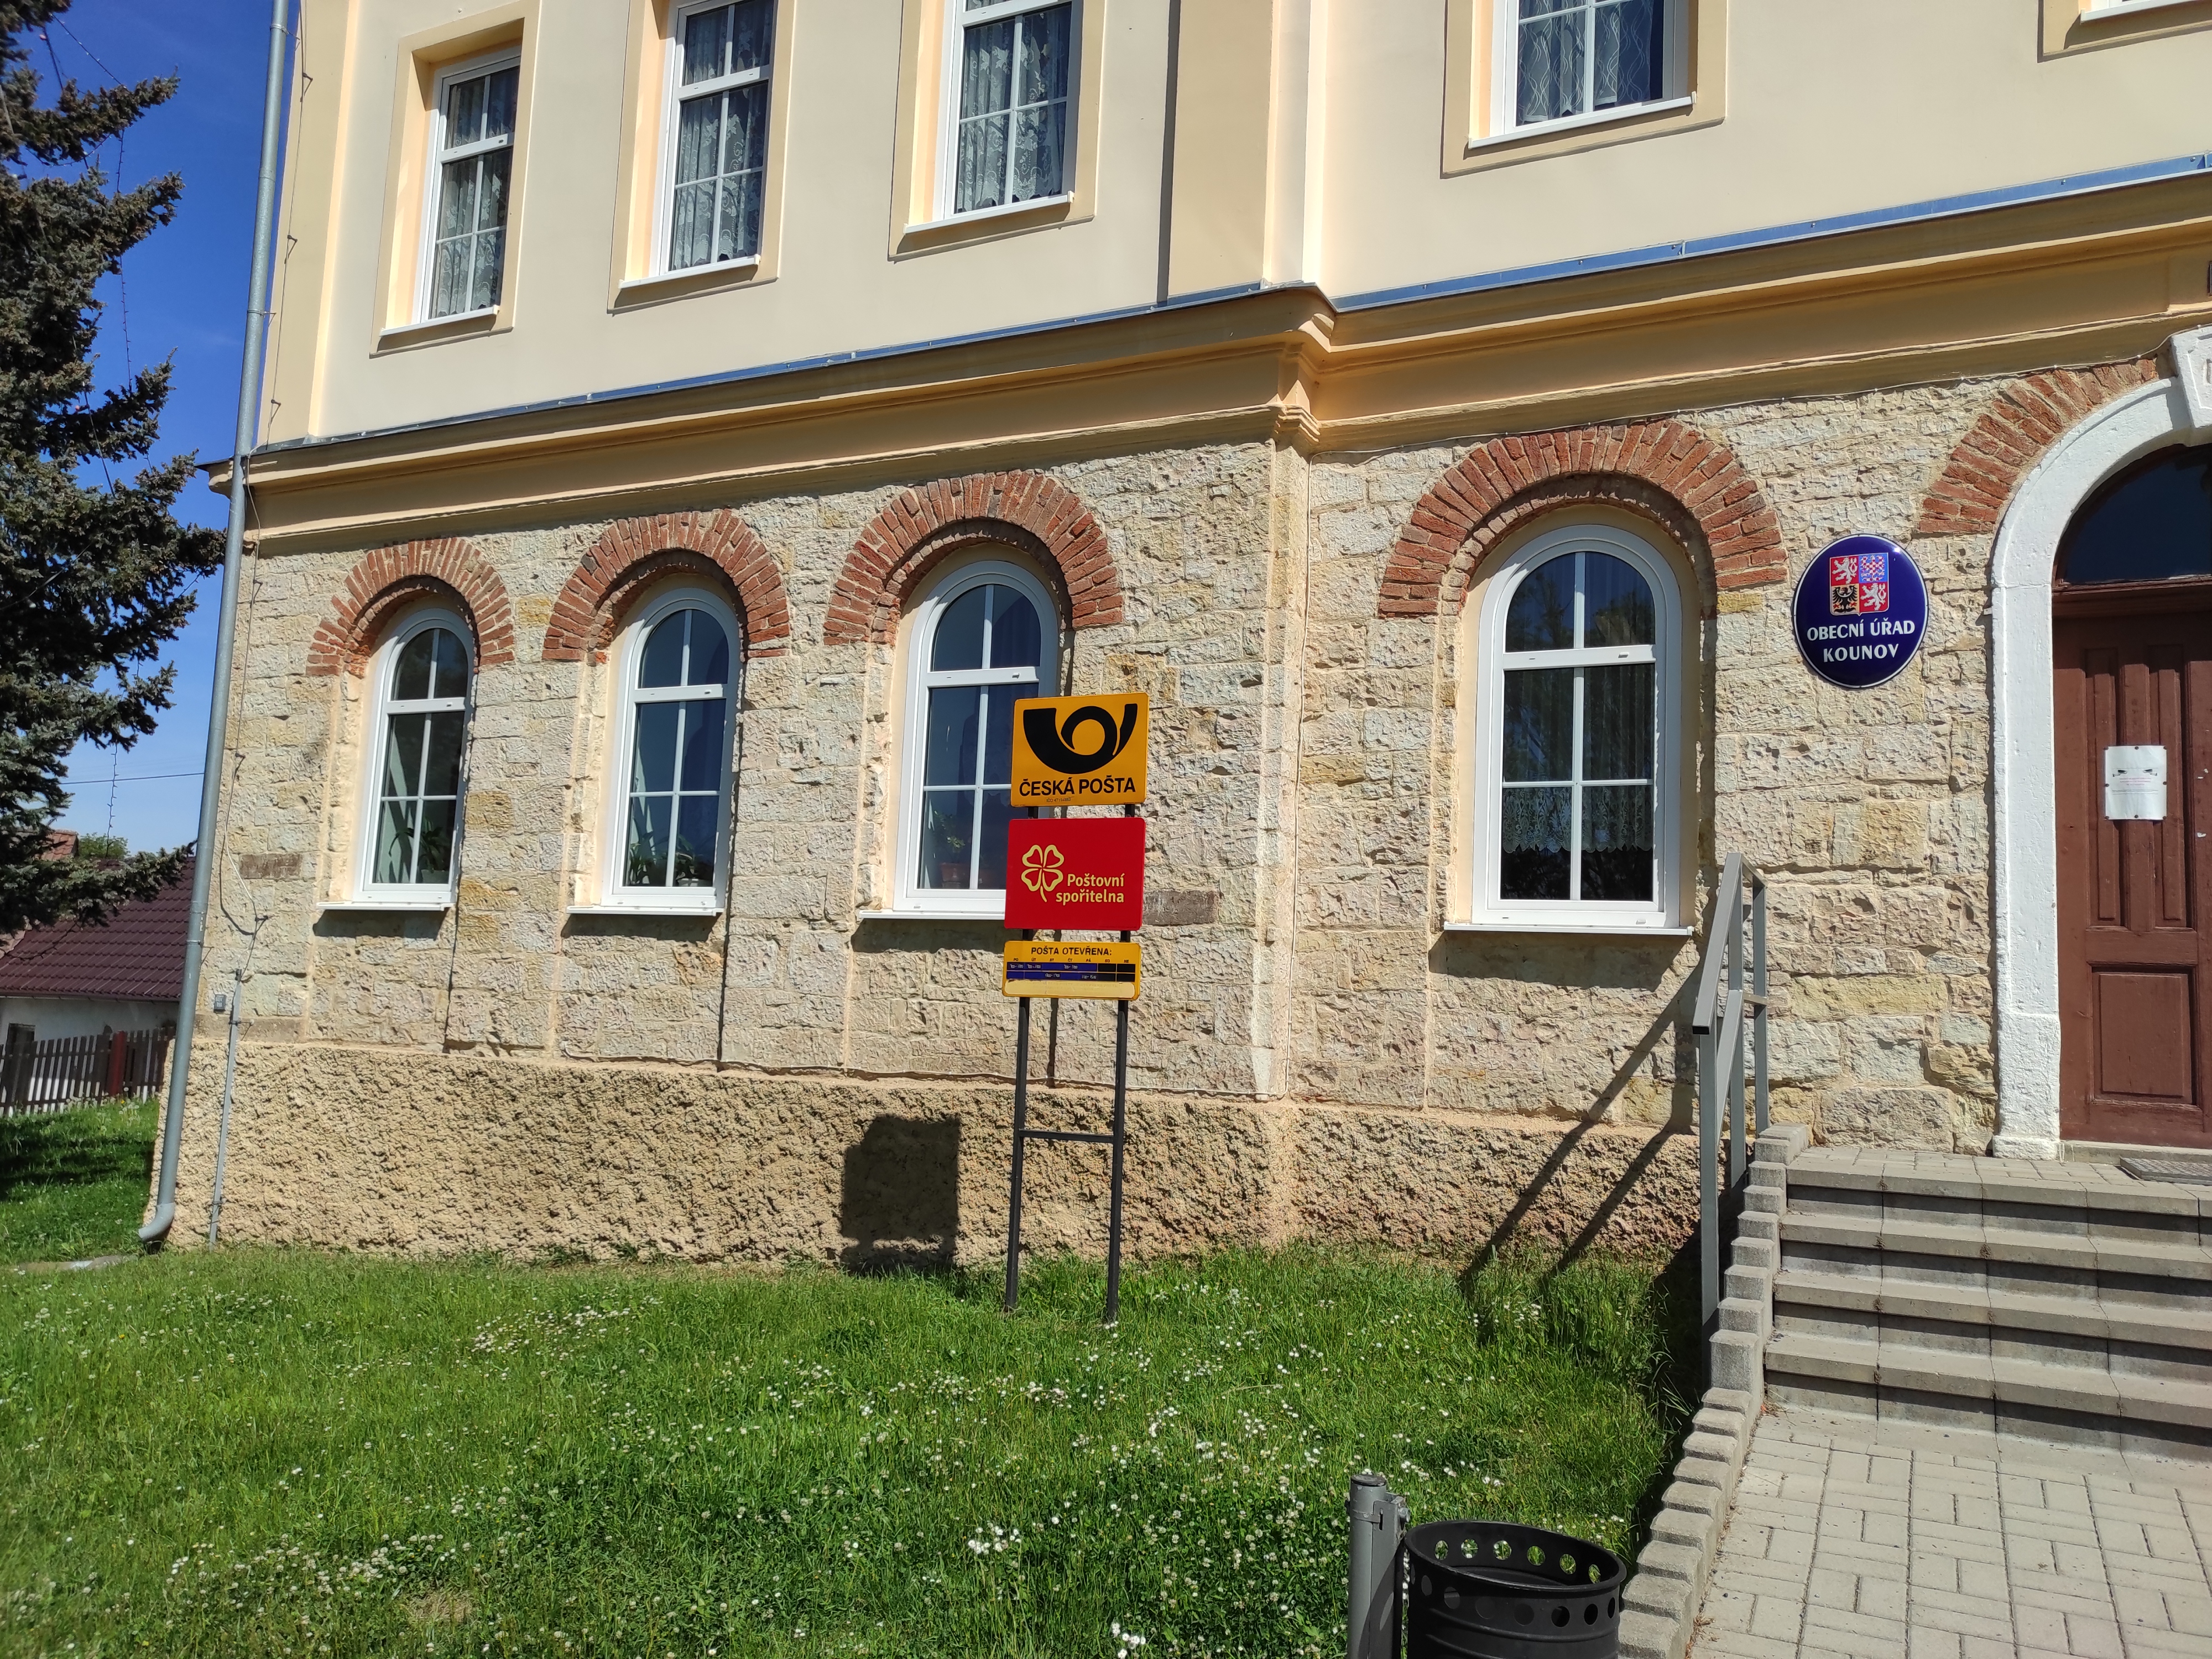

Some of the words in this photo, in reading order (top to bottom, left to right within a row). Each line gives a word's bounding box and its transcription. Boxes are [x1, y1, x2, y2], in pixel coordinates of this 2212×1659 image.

[1807, 619, 1864, 641] OBECNÍ
[1871, 617, 1915, 636] ÚŘAD
[1823, 643, 1899, 662] KOUNOV
[1019, 777, 1074, 797] ČESKÁ
[1079, 775, 1136, 794] POŠTA
[1067, 873, 1125, 888] Poštovní
[1056, 889, 1124, 906] spořitelna
[1031, 946, 1059, 955] POŠTA
[1062, 946, 1112, 956] OTEVŘENA:
